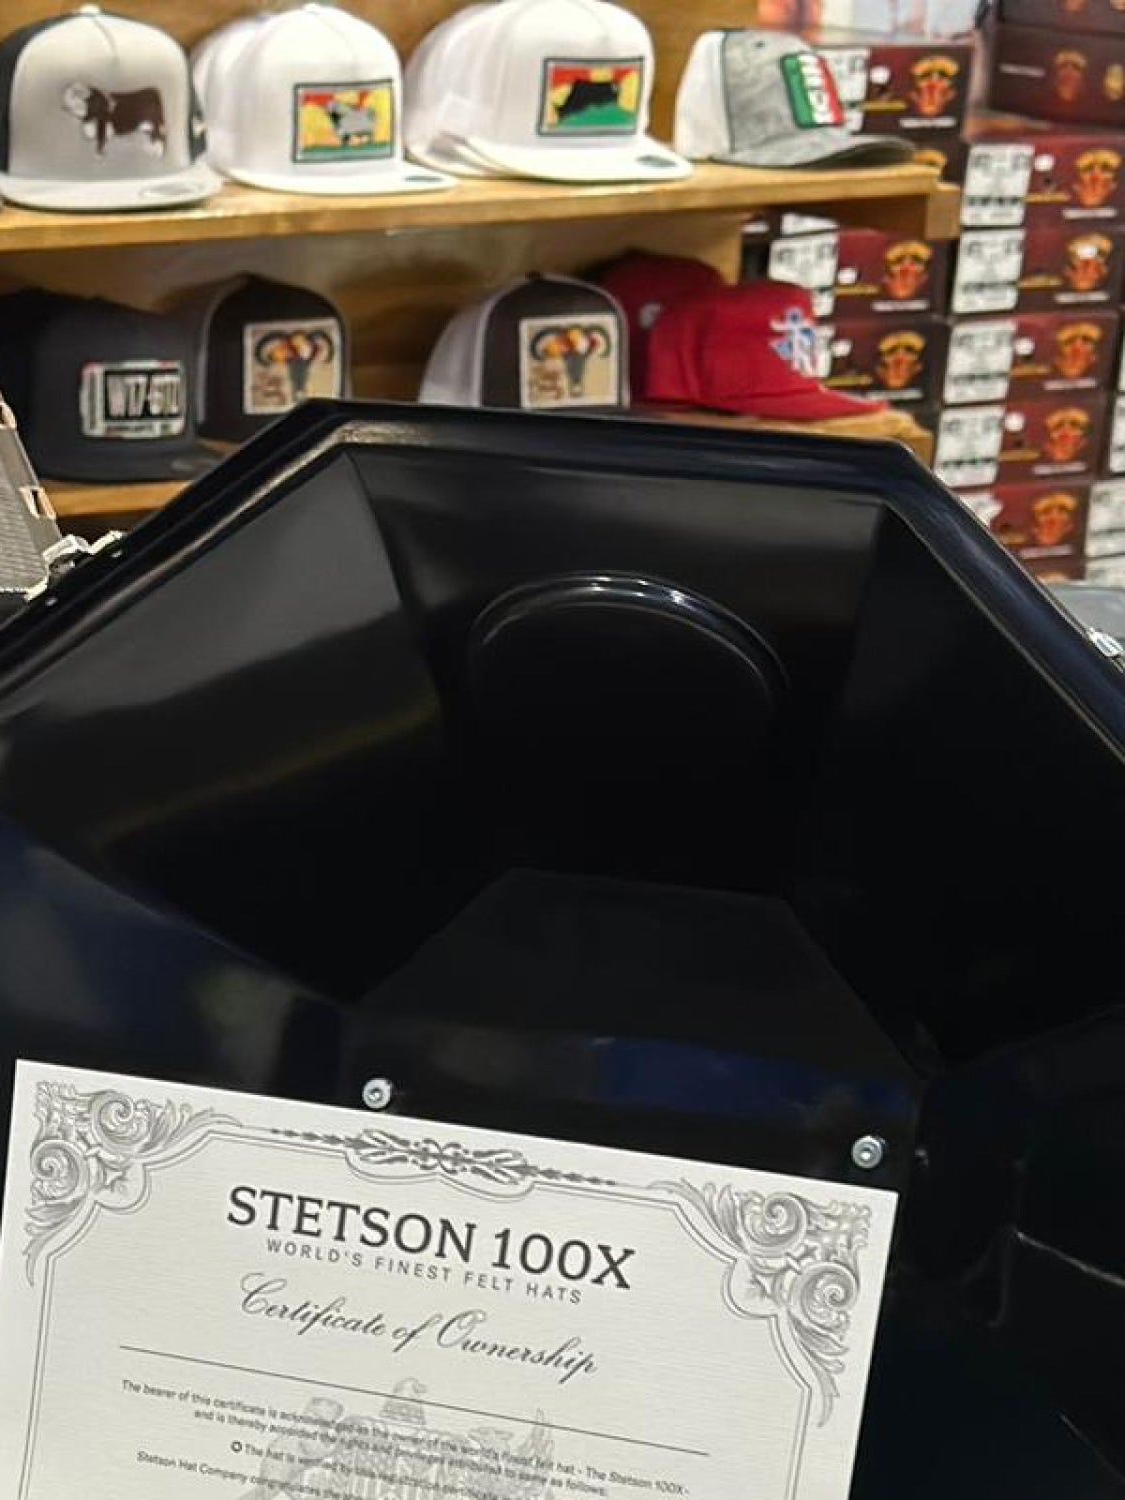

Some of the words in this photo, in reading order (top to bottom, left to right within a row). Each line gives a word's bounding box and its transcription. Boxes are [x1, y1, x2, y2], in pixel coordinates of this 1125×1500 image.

[226, 1184, 478, 1264] STETSON
[491, 1227, 637, 1291] 100X
[266, 1237, 363, 1268] WORLD'S
[374, 1255, 452, 1283] FINEST
[464, 1270, 514, 1292] FELT
[526, 1281, 583, 1305] HATS
[241, 1272, 387, 1336] Certificate
[392, 1313, 443, 1352] of
[437, 1308, 598, 1384] Ownership
[122, 1379, 142, 1394] The
[143, 1384, 176, 1401] bearer
[178, 1390, 191, 1401] of
[213, 1398, 267, 1417] certificate
[586, 1466, 606, 1481] The
[608, 1471, 653, 1489] Stetson
[136, 1450, 176, 1467] Stetson
[178, 1458, 197, 1471] Hat
[199, 1462, 248, 1485] Company
